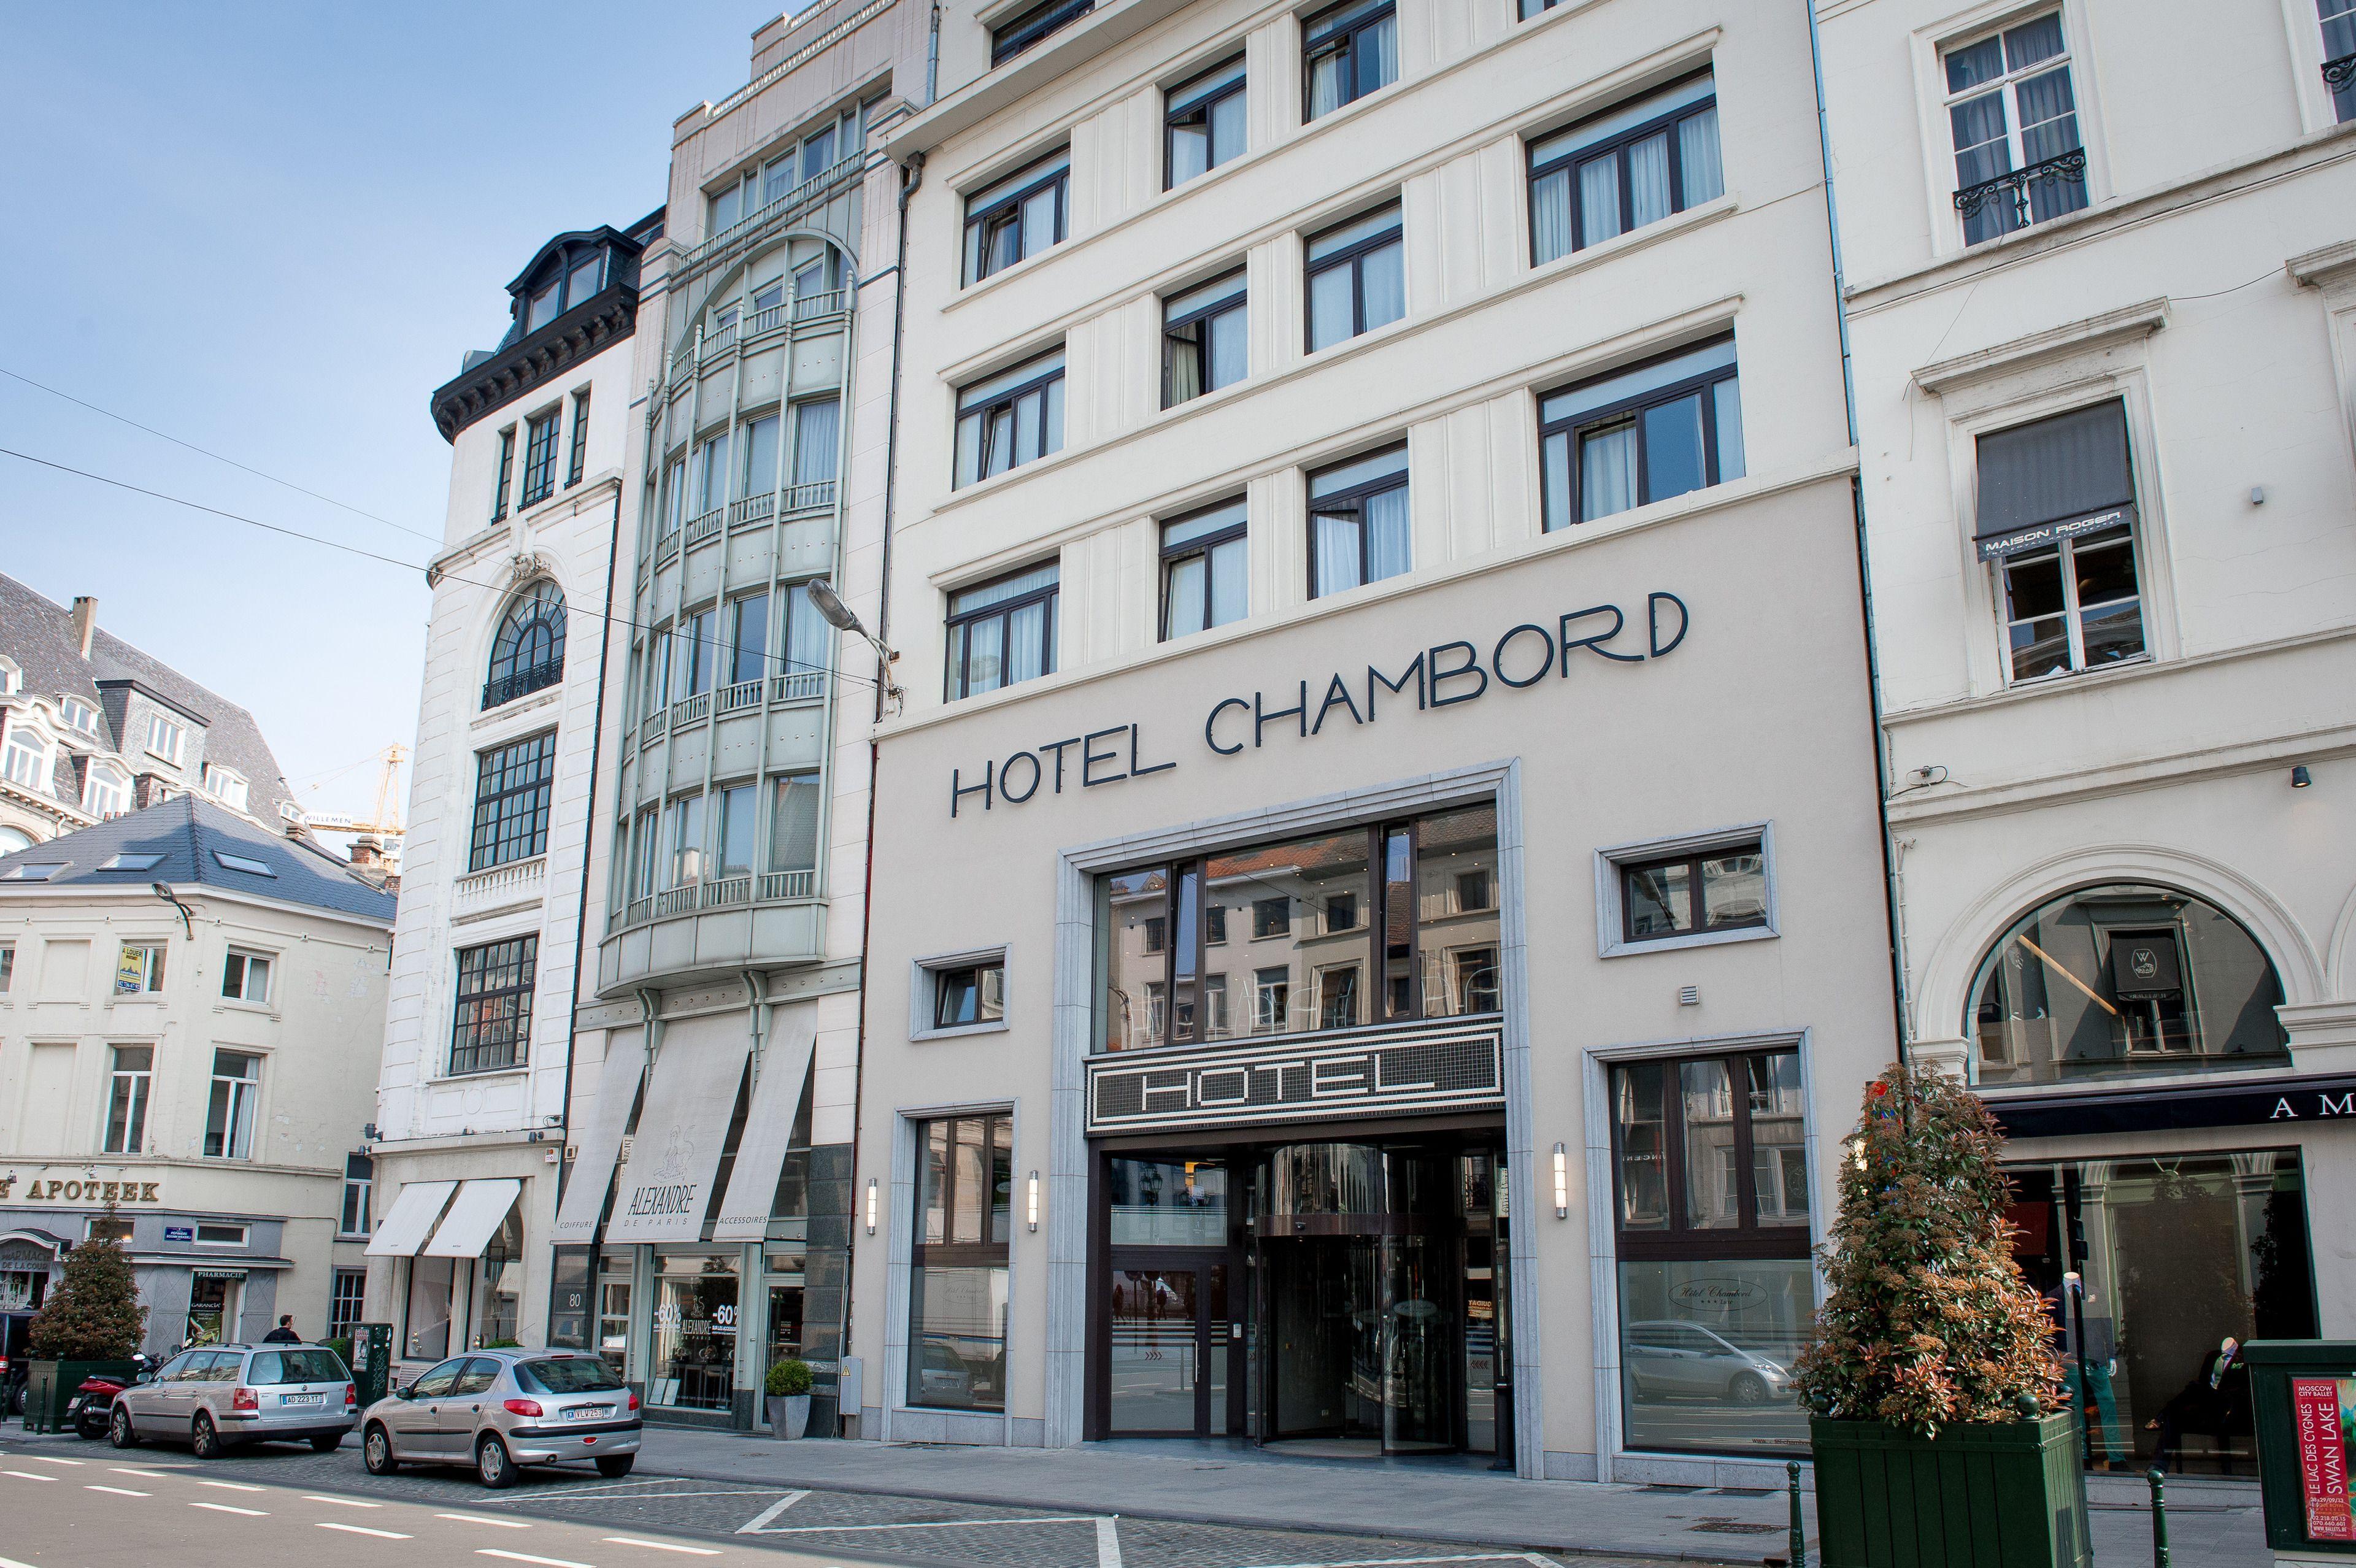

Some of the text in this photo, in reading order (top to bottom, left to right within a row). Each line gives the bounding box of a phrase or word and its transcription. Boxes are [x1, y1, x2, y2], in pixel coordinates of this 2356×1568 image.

[1985, 511, 2121, 551] MAISON ROGER
[952, 591, 1689, 818] HOTEL CHAMBORD
[1142, 1053, 1435, 1111] HOTEL
[26, 1180, 160, 1202] APOTEEK
[628, 1183, 698, 1216] ALEXANDRE
[647, 1218, 688, 1226] PARIS
[718, 1215, 768, 1224] ACCESSOIRES
[569, 1293, 581, 1307] 80
[1707, 1286, 1753, 1297] Chambord
[654, 1304, 682, 1323] -60%
[682, 1320, 712, 1335] ALEXANDRE
[2318, 1403, 2337, 1440] LAKE
[2300, 1403, 2321, 1494] LE LAC DES CYGNES
[2323, 1446, 2343, 1494] SWAN
